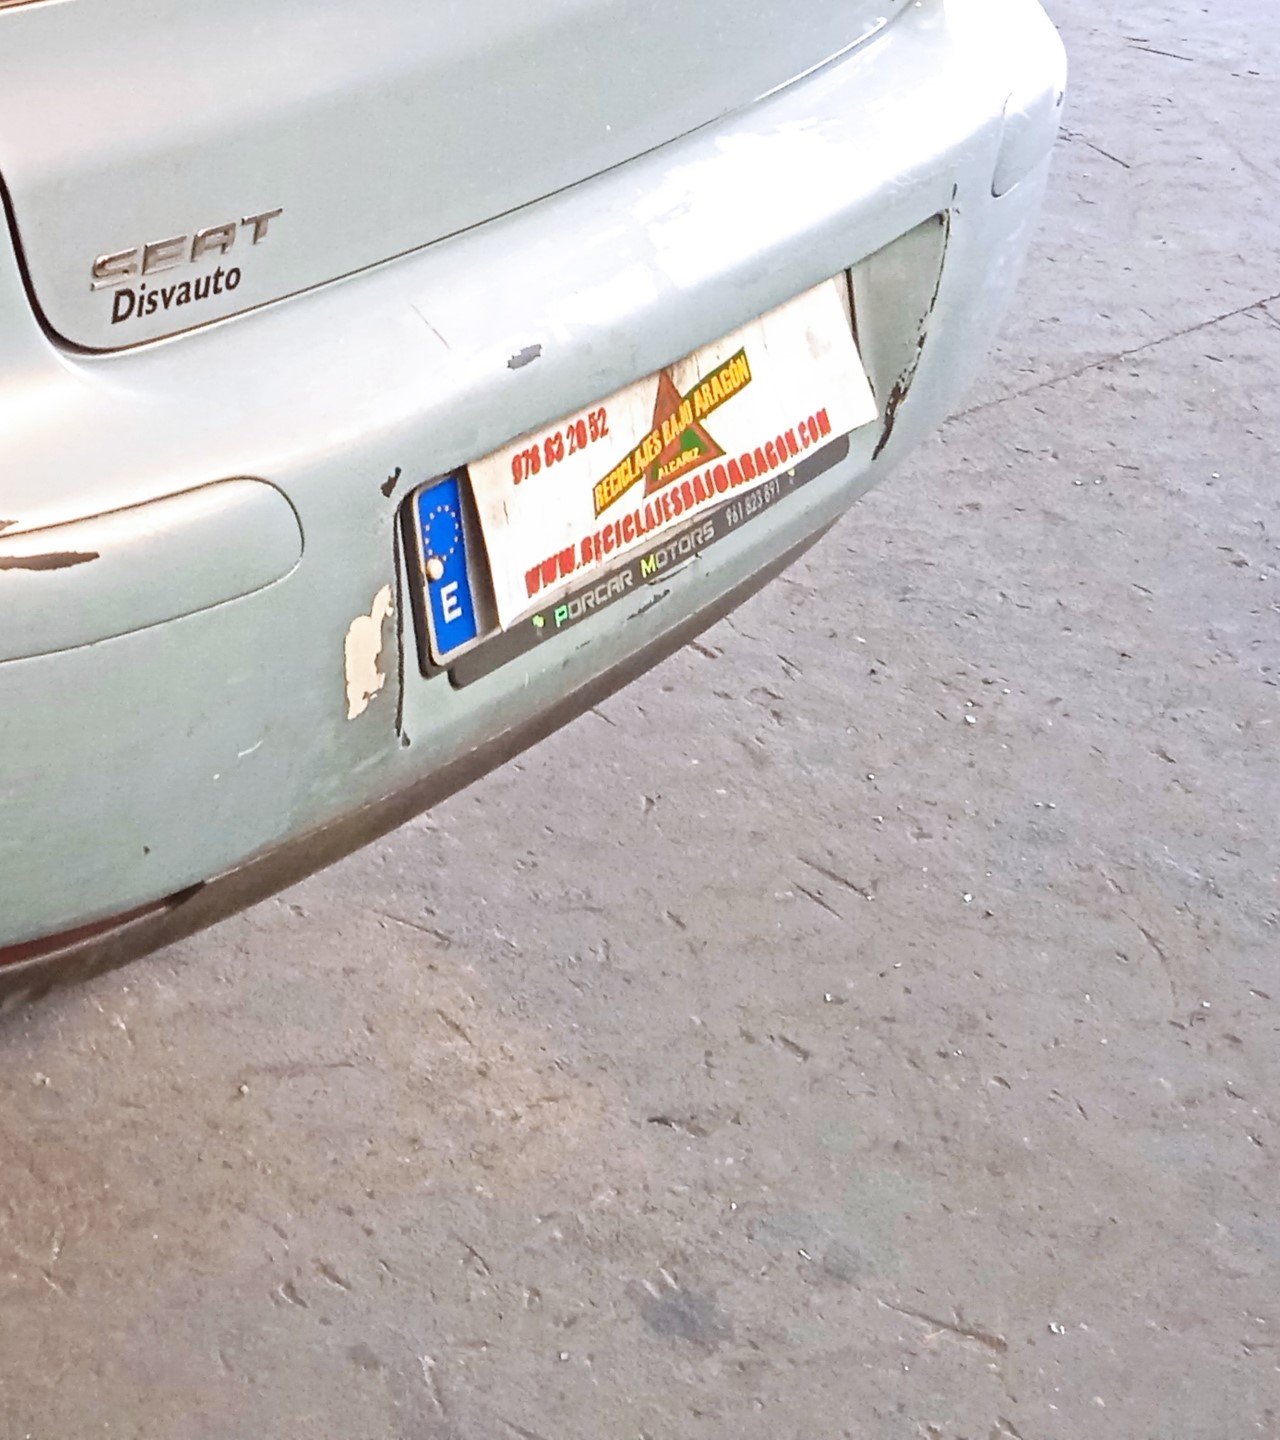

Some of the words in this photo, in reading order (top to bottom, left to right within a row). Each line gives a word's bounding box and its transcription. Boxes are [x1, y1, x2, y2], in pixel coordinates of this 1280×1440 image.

[90, 207, 283, 291] SEAT
[111, 265, 241, 325] Disvauto
[511, 444, 541, 485] 978
[566, 419, 588, 456] 20
[587, 406, 609, 443] 52
[595, 428, 663, 511] RECICLAJES
[661, 399, 694, 448] BAJO
[693, 354, 750, 417] ARAGÓN
[524, 407, 832, 599] WWW.RECICLAJESBAJOARAGON.COM
[440, 581, 463, 625] E
[554, 569, 634, 628] PORCAR
[640, 520, 715, 578] MOTORS
